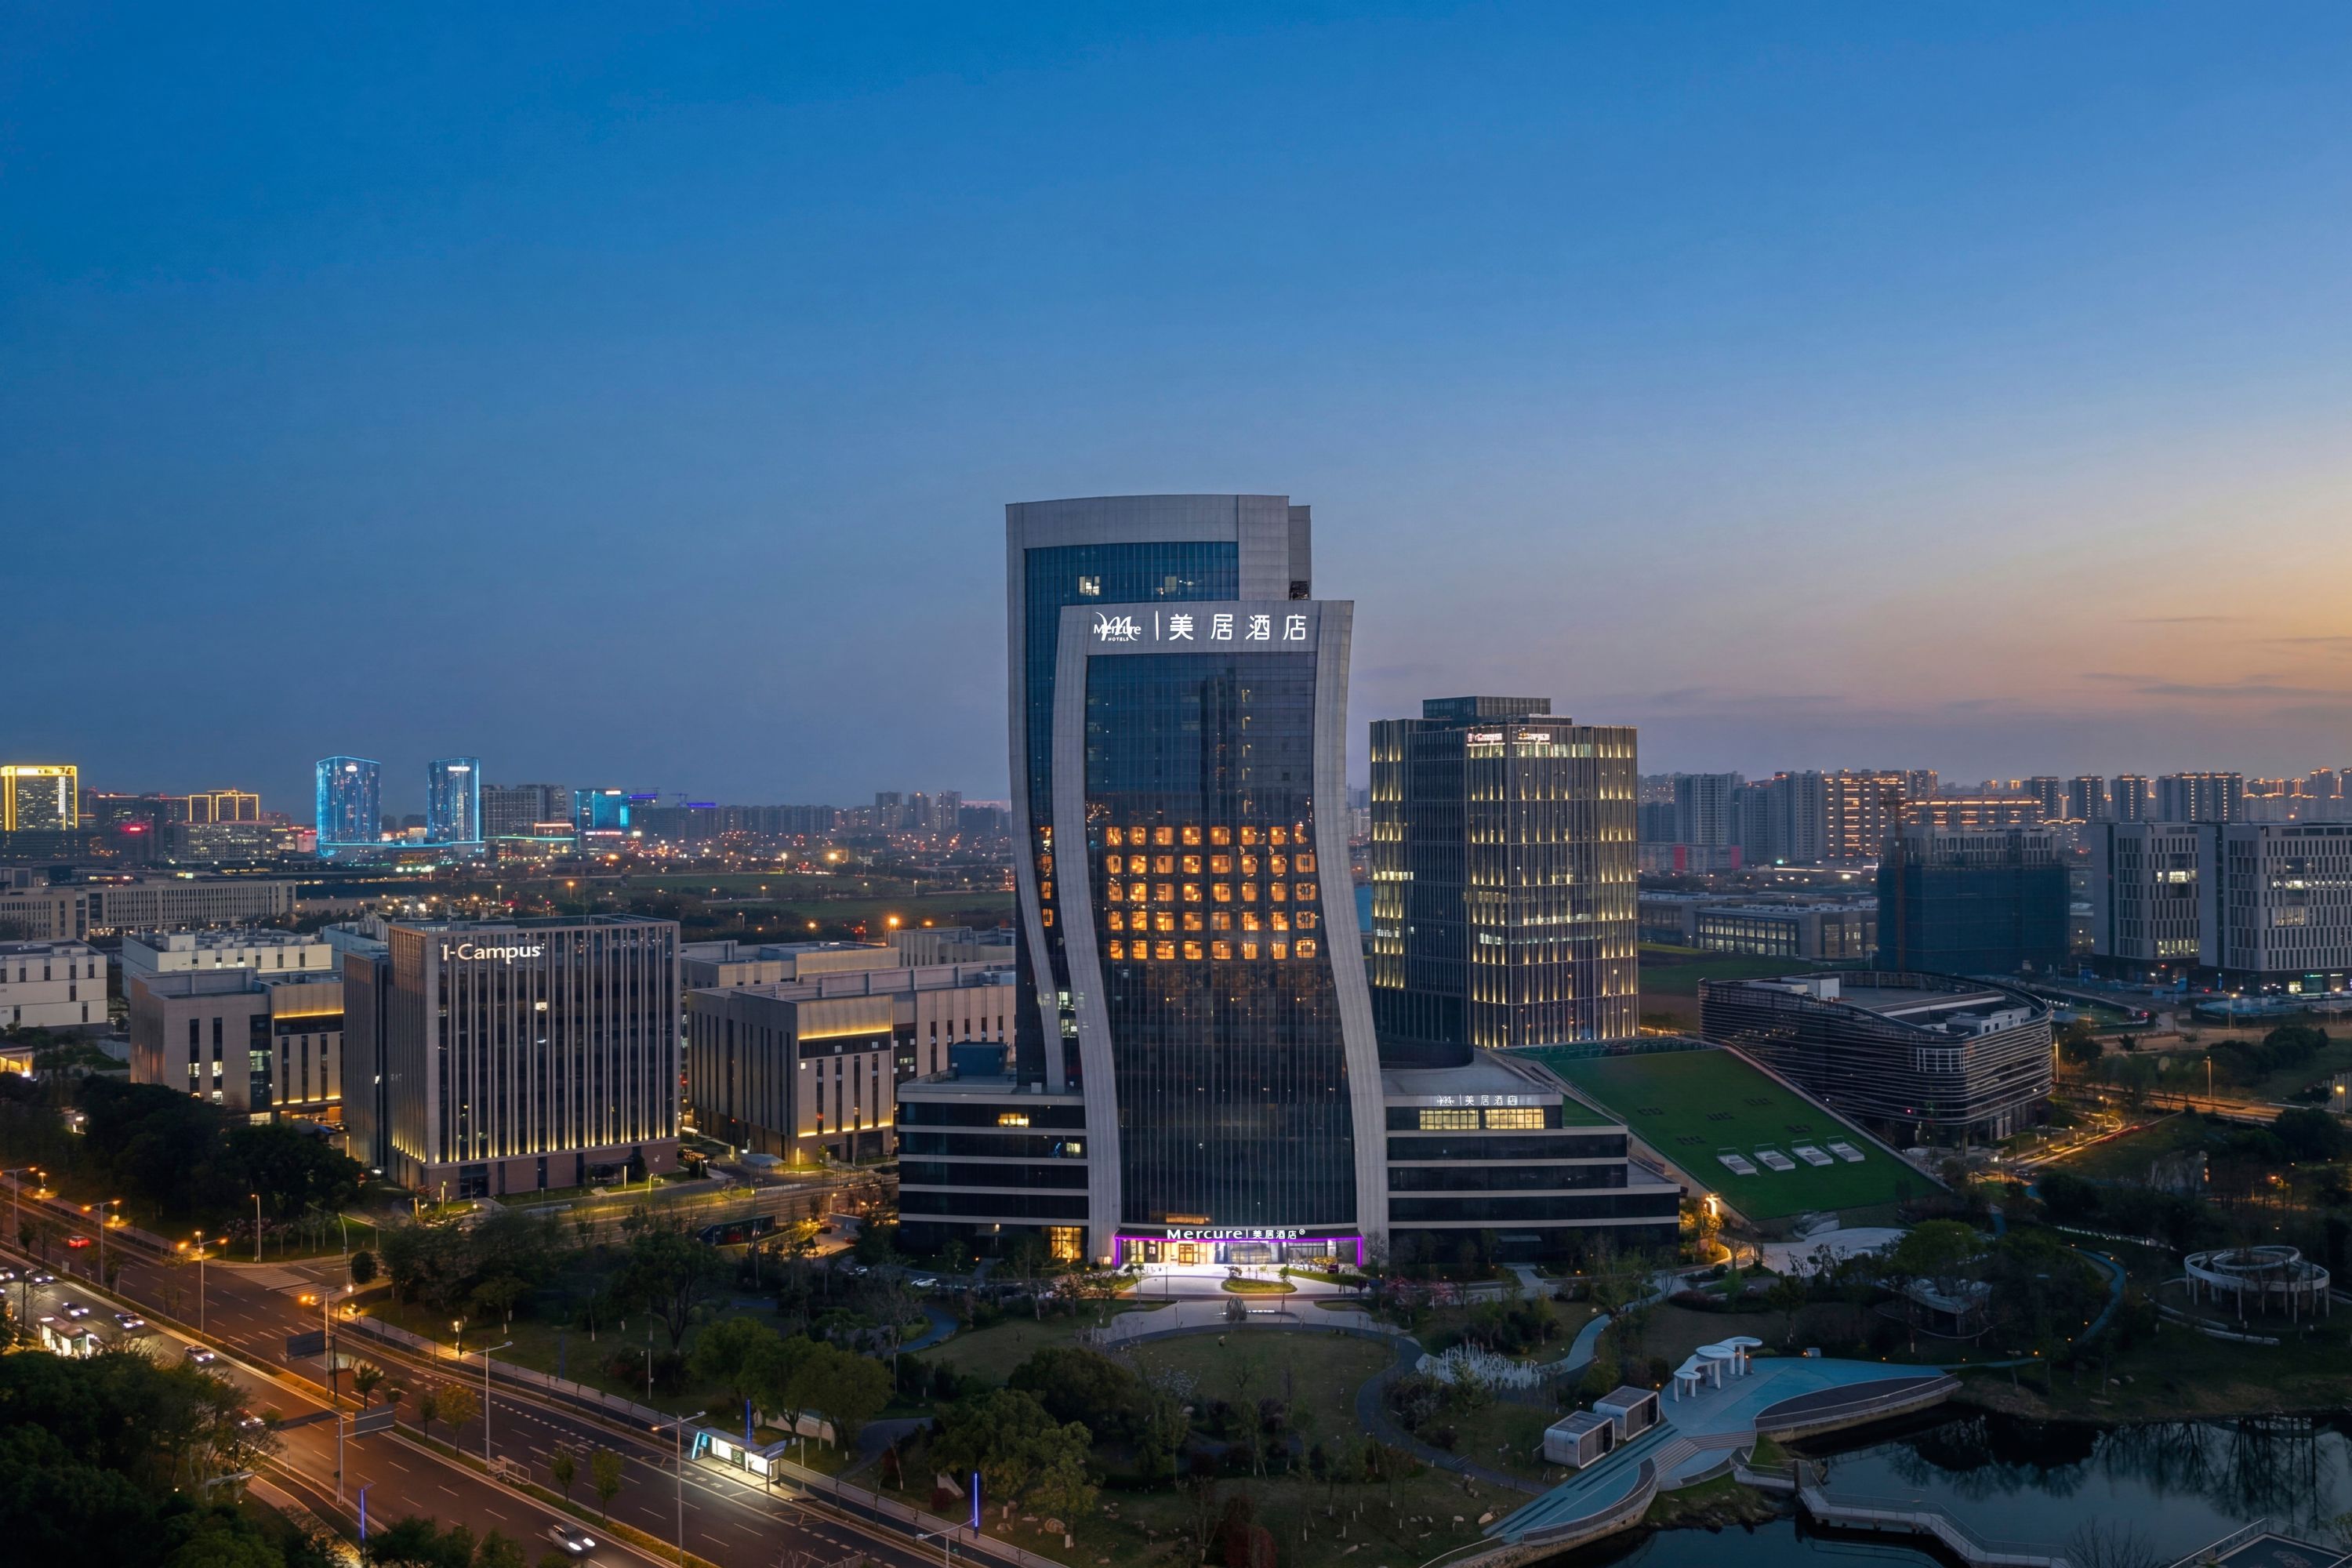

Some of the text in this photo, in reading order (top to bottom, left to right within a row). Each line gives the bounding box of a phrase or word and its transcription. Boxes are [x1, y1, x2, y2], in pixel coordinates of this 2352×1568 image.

[1169, 614, 1306, 641] 美居酒店
[443, 943, 541, 964] I-Campus
[1465, 1094, 1518, 1105] 美居酒店
[1167, 1229, 1243, 1240] Mercure
[1253, 1229, 1297, 1240] 美居酒店
